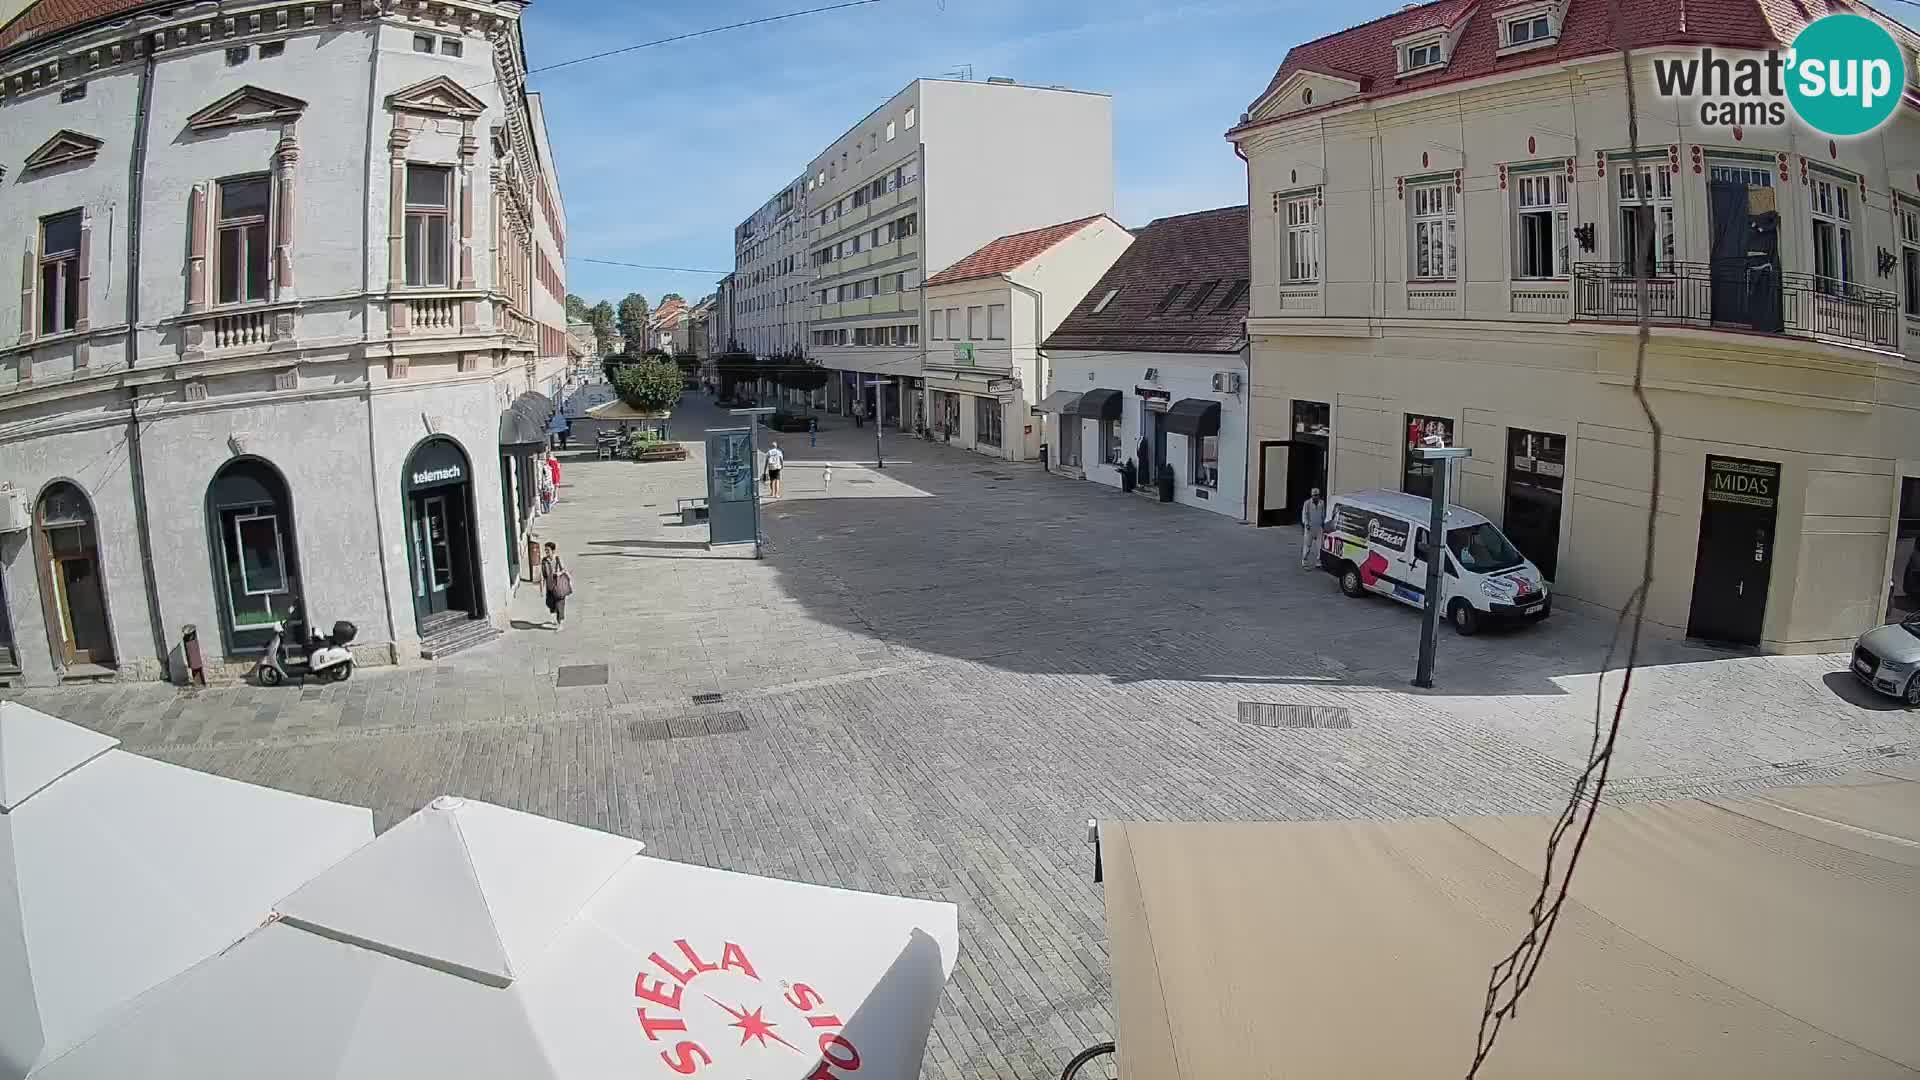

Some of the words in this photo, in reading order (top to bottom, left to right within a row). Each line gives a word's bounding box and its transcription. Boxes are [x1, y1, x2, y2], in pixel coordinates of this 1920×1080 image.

[413, 465, 461, 484] telemach
[1714, 473, 1769, 496] MIDAS
[635, 938, 761, 1075] STELLA
